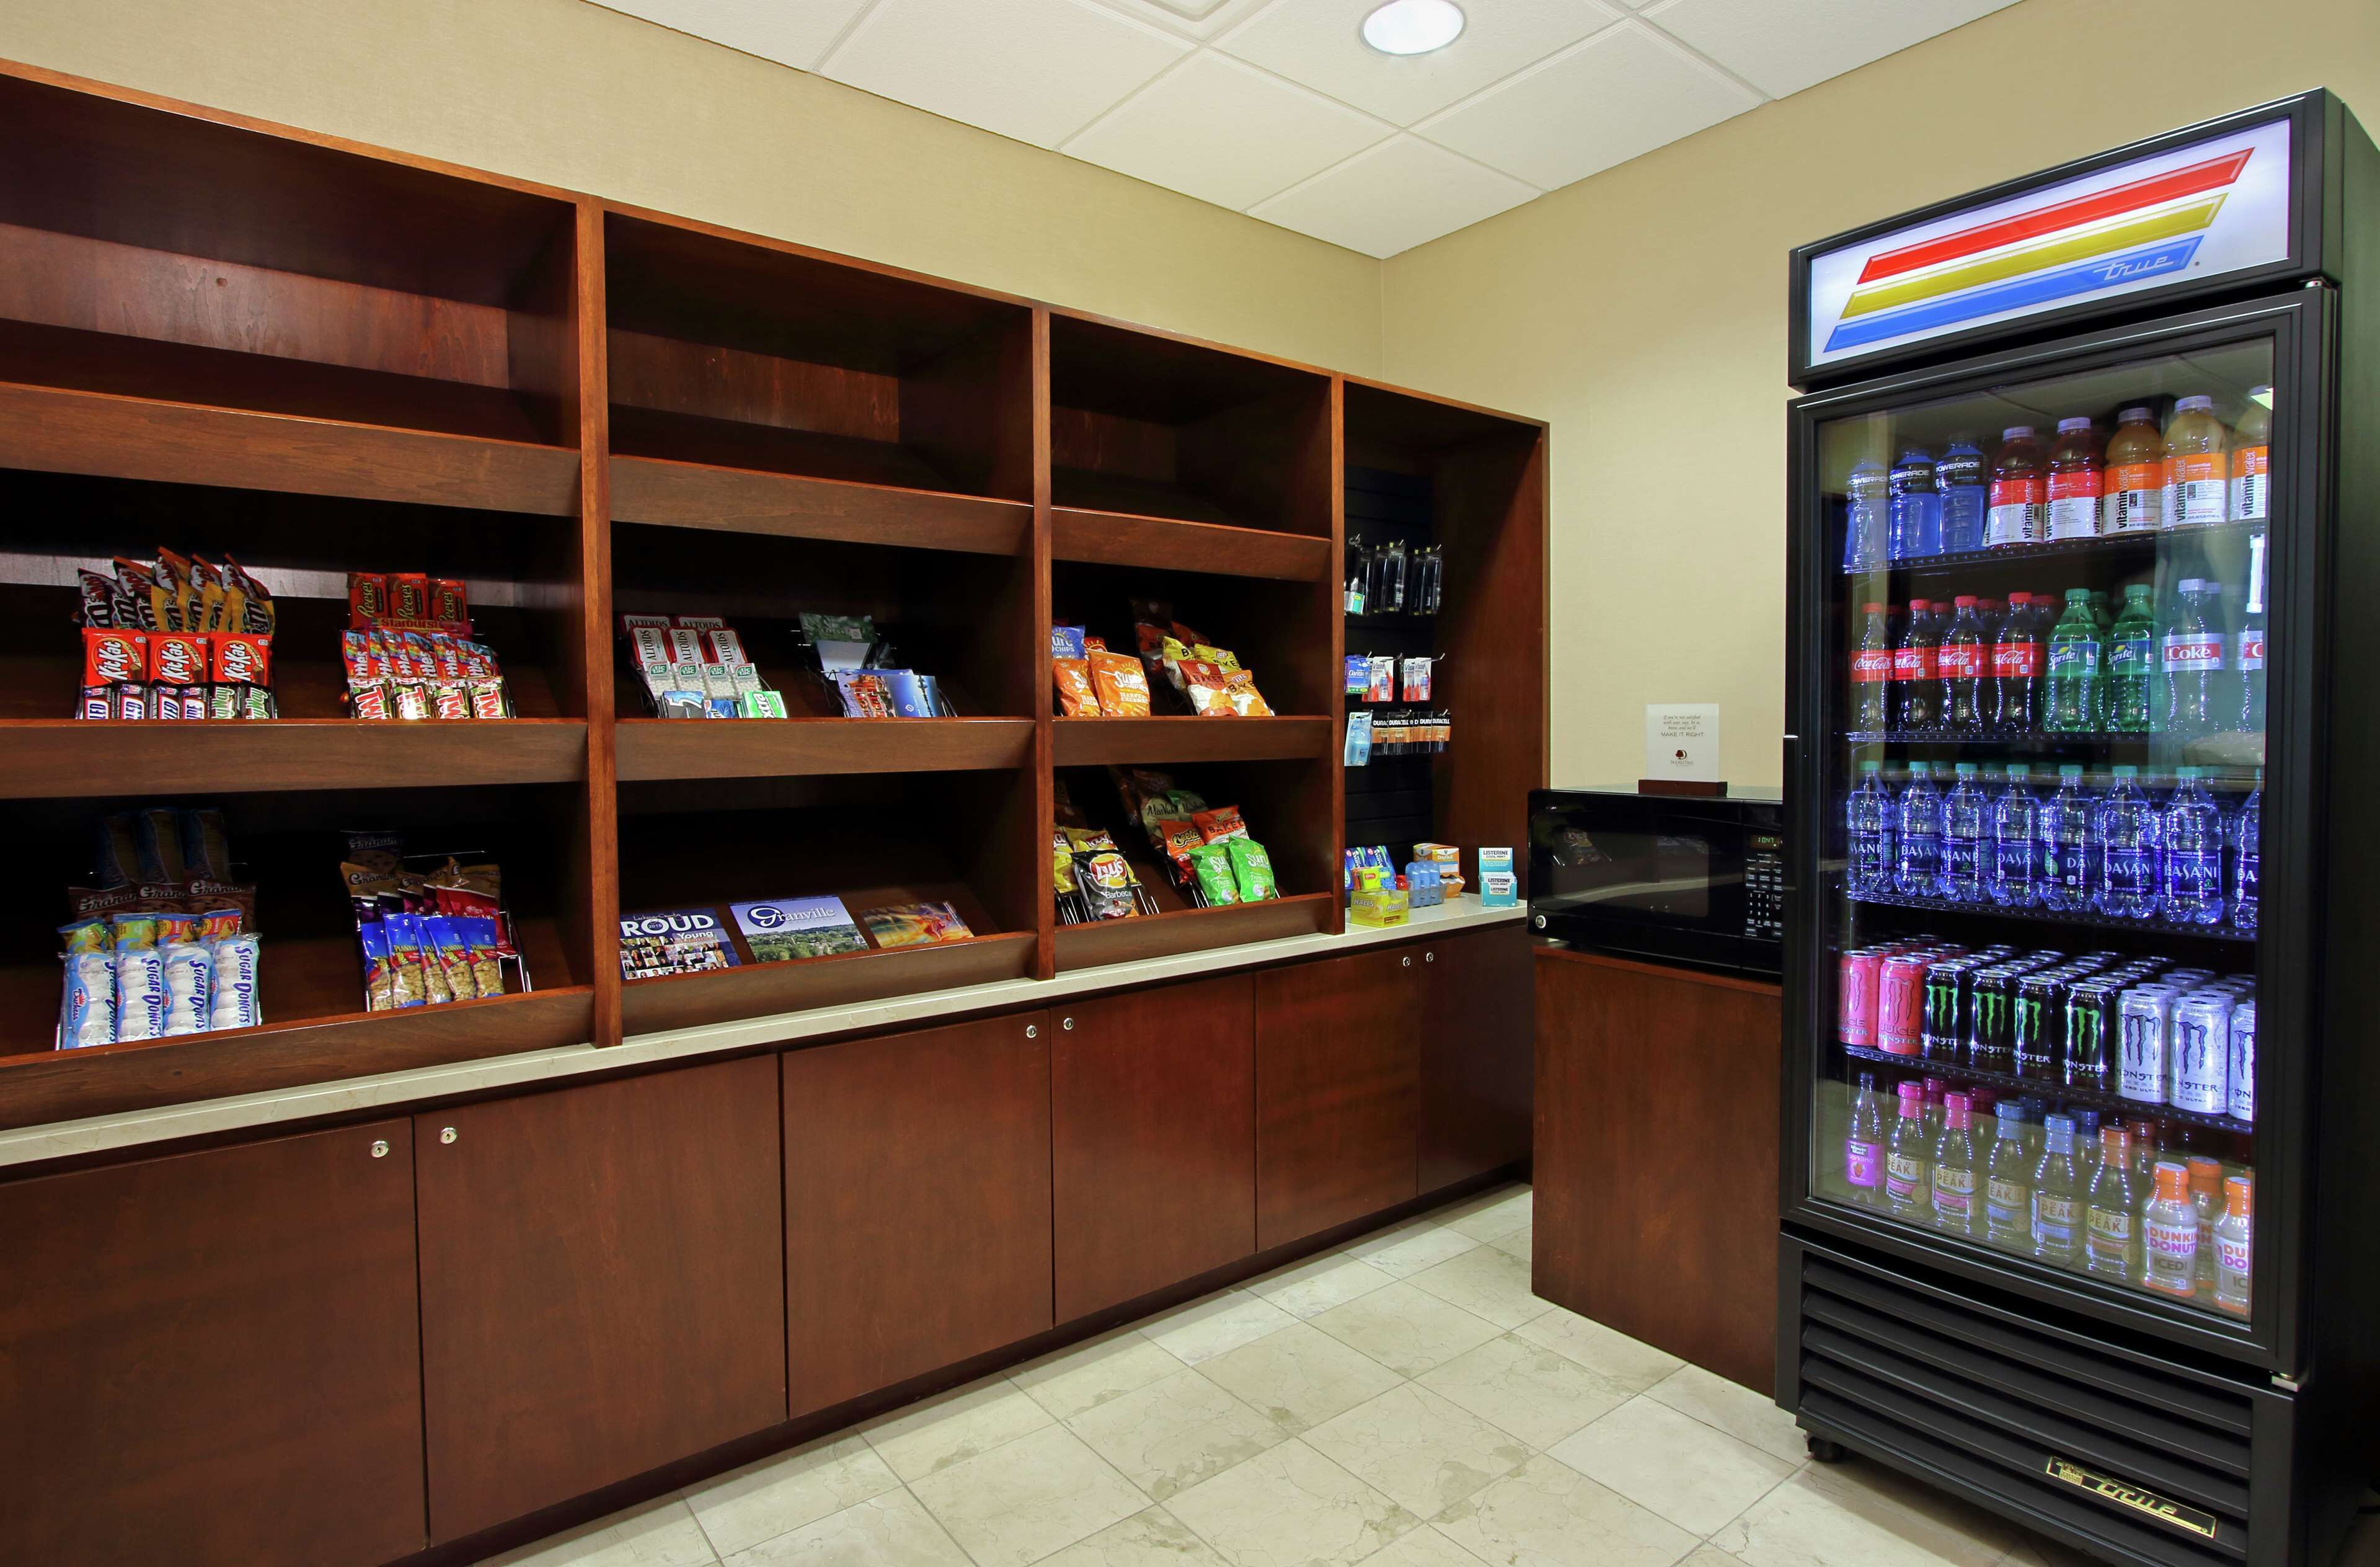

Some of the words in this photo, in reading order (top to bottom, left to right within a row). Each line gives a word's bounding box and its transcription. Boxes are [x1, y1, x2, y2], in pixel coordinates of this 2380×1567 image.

[2093, 256, 2175, 280] true
[640, 630, 657, 660] ALTOIDS
[676, 631, 693, 662] ALTOIDS
[1052, 636, 1073, 647] un
[2049, 651, 2077, 669] Sprite
[2170, 645, 2211, 660] Coke
[1172, 828, 1199, 846] Cheeto
[2164, 866, 2217, 880] DASANI
[1354, 898, 1374, 907] HALLS
[621, 915, 714, 937] ROUD
[749, 907, 837, 927] Granville
[678, 931, 714, 940] Young
[234, 946, 252, 982] SUGAR
[144, 959, 161, 994] SUGAR
[188, 959, 207, 998] SUGAR
[1880, 1024, 1917, 1036] JUICE
[1937, 1172, 1965, 1188] PEAK
[2041, 1205, 2074, 1219] PEAK
[2089, 1215, 2121, 1232] PEAK
[2083, 1476, 2202, 1530] true
